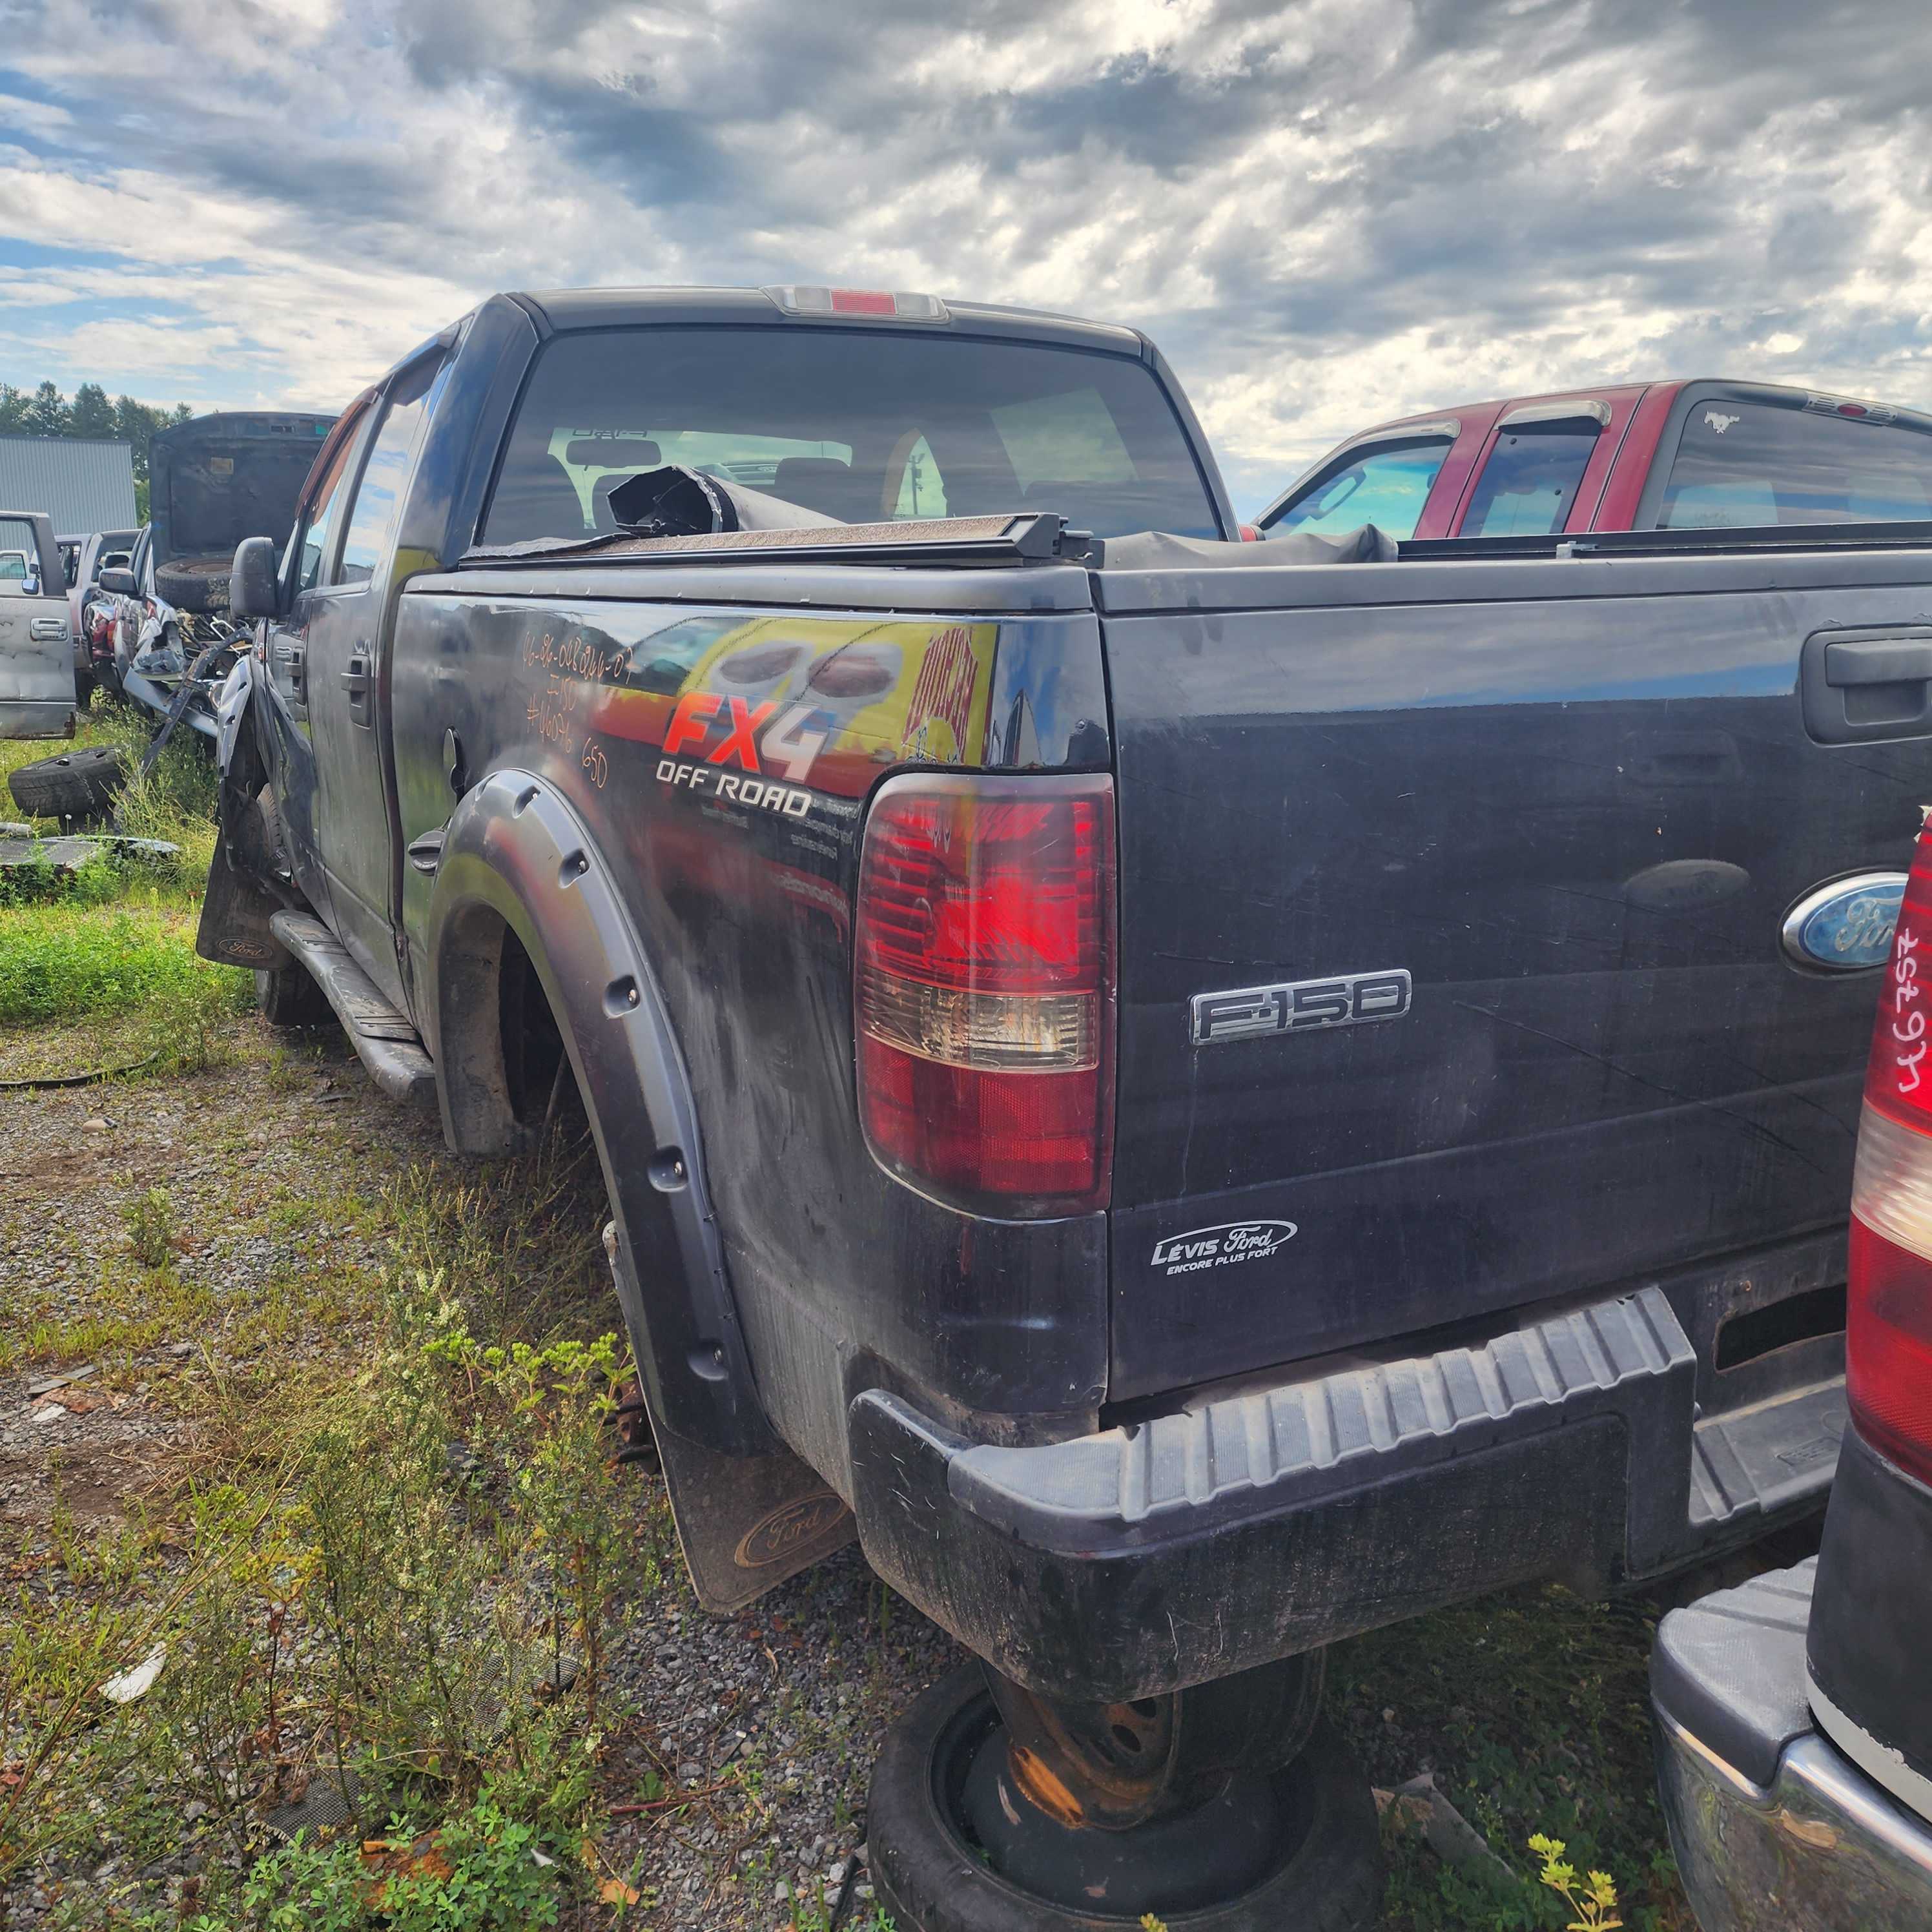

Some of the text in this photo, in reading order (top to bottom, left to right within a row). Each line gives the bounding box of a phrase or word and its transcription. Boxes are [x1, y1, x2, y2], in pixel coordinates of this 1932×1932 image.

[582, 737, 608, 788] 650
[661, 690, 830, 782] FX4
[656, 759, 812, 817] OFF ROAD
[229, 941, 263, 956] Ford
[1834, 897, 1904, 952] For
[1199, 975, 1407, 1040] F-150
[1893, 928, 1926, 1093] 46757
[1166, 1246, 1278, 1275] ENCORE PLUS FORT
[1224, 1226, 1273, 1253] Ford
[767, 1507, 821, 1549] Ford
